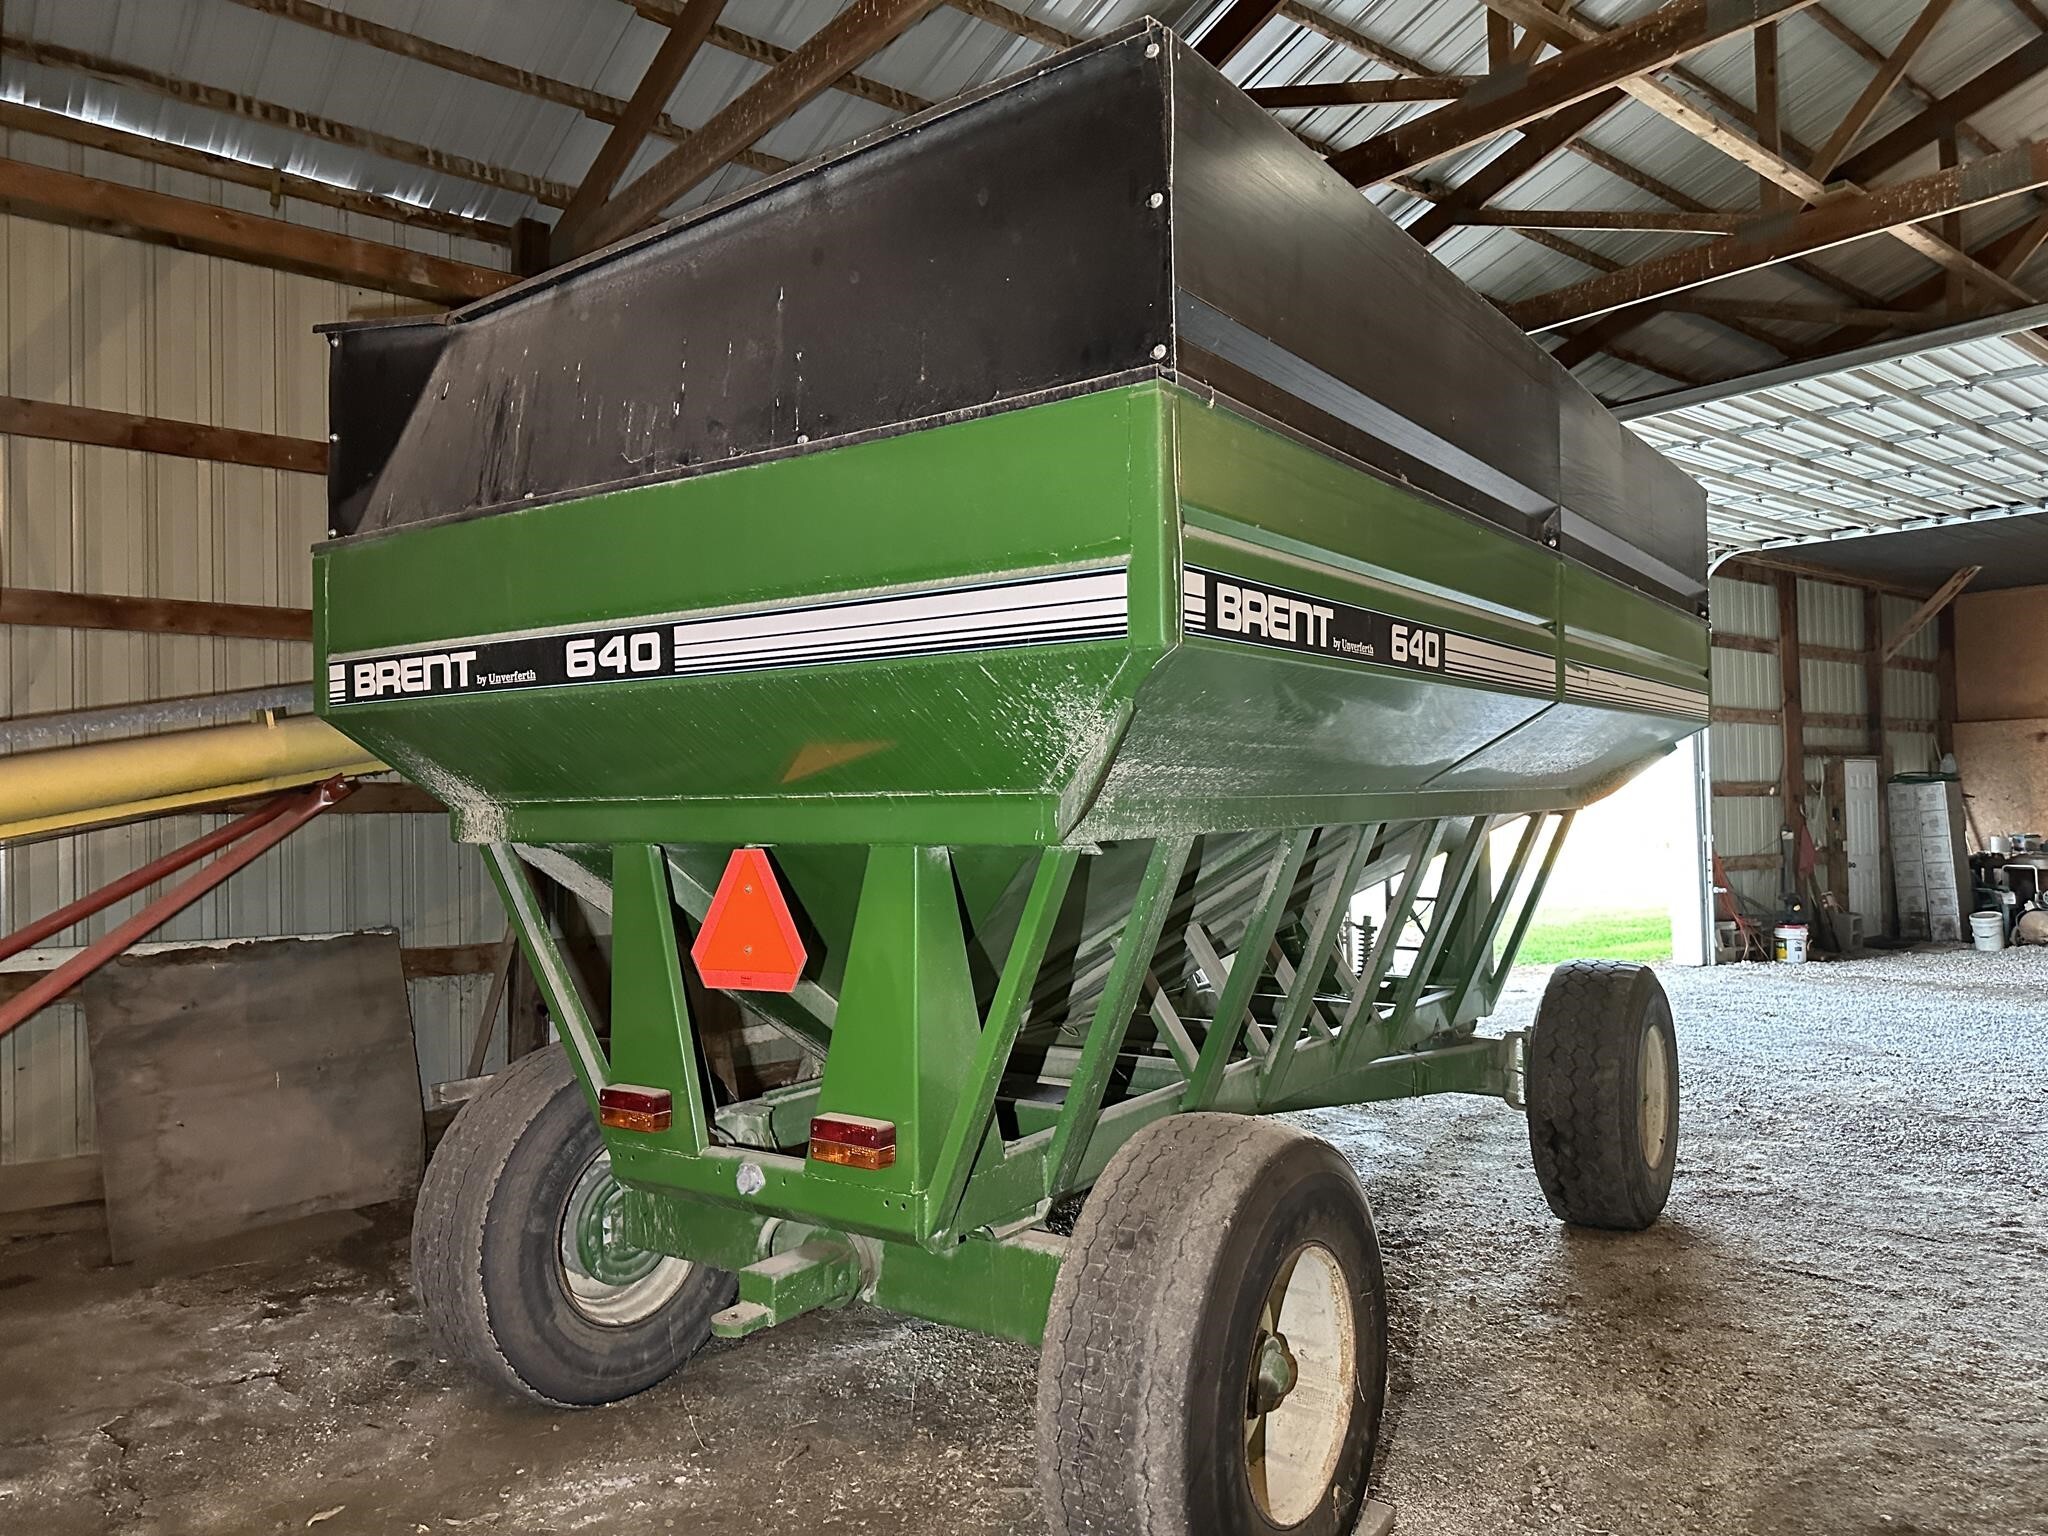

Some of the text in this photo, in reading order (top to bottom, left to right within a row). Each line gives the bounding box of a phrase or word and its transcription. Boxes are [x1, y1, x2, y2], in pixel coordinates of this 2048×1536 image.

[1216, 581, 1334, 649] BRENT
[1332, 636, 1341, 652] by
[1390, 623, 1440, 668] 640
[353, 631, 661, 699] BRENT by Unverferth 640
